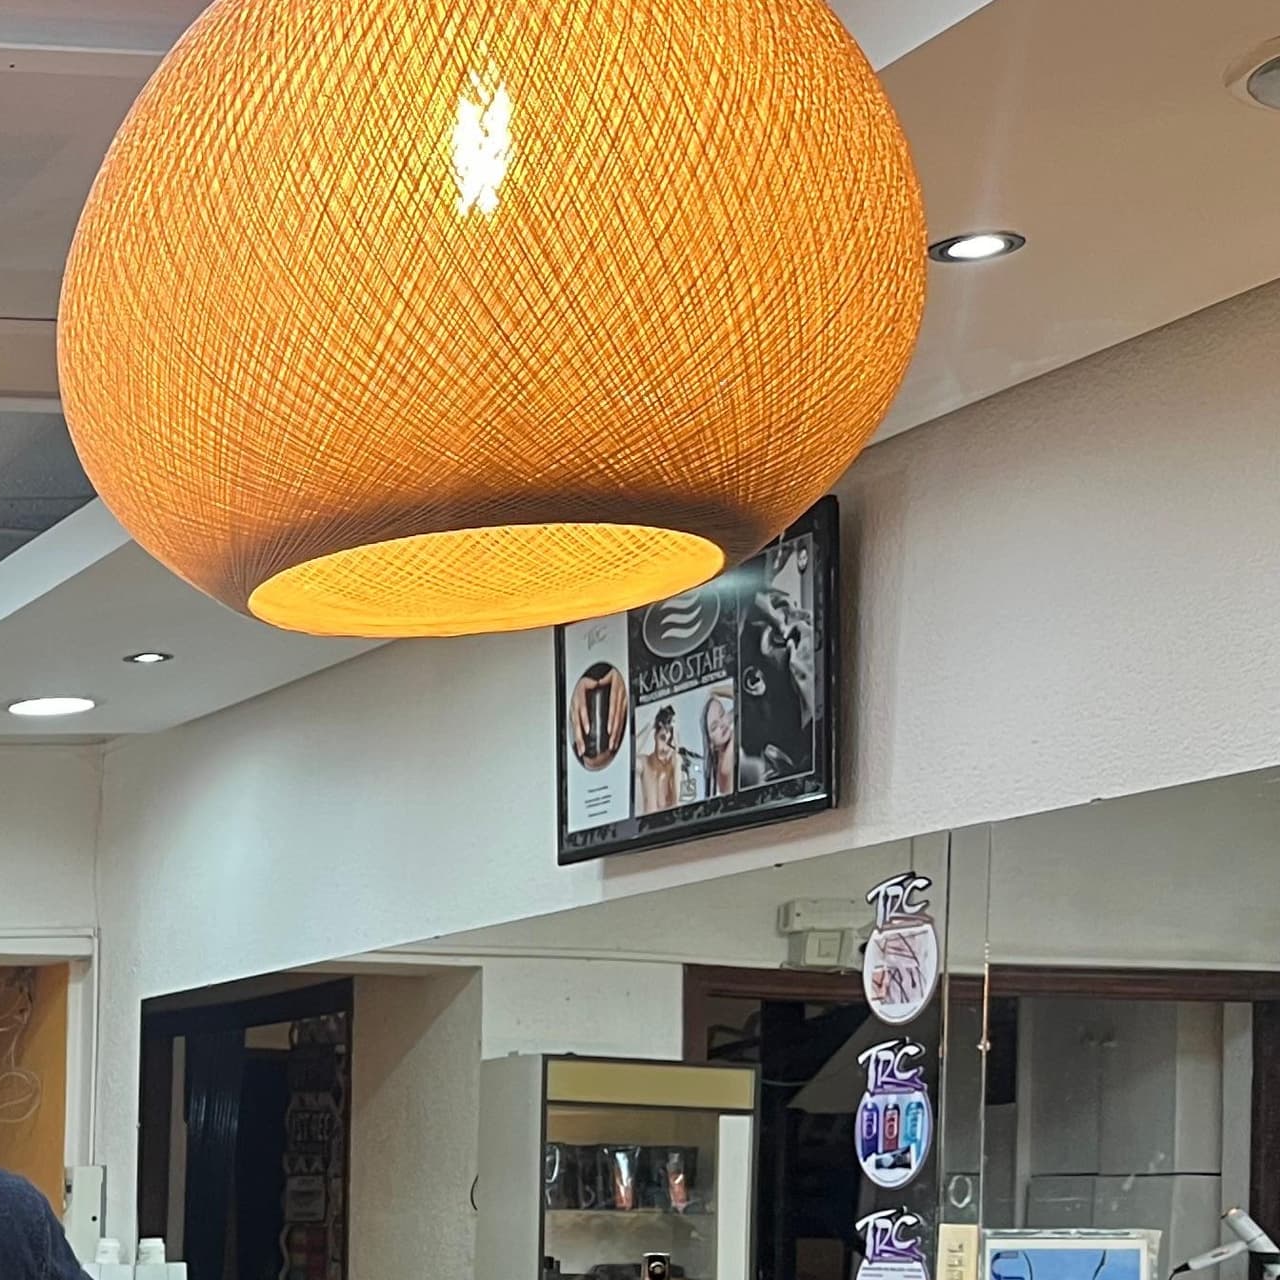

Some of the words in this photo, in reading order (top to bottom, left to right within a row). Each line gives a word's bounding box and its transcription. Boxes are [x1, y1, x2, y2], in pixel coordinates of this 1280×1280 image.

[639, 660, 684, 694] KAKO
[686, 643, 728, 679] STAFF
[866, 871, 934, 931] TRC
[858, 1040, 926, 1094] TRC
[855, 1208, 923, 1263] TRC
